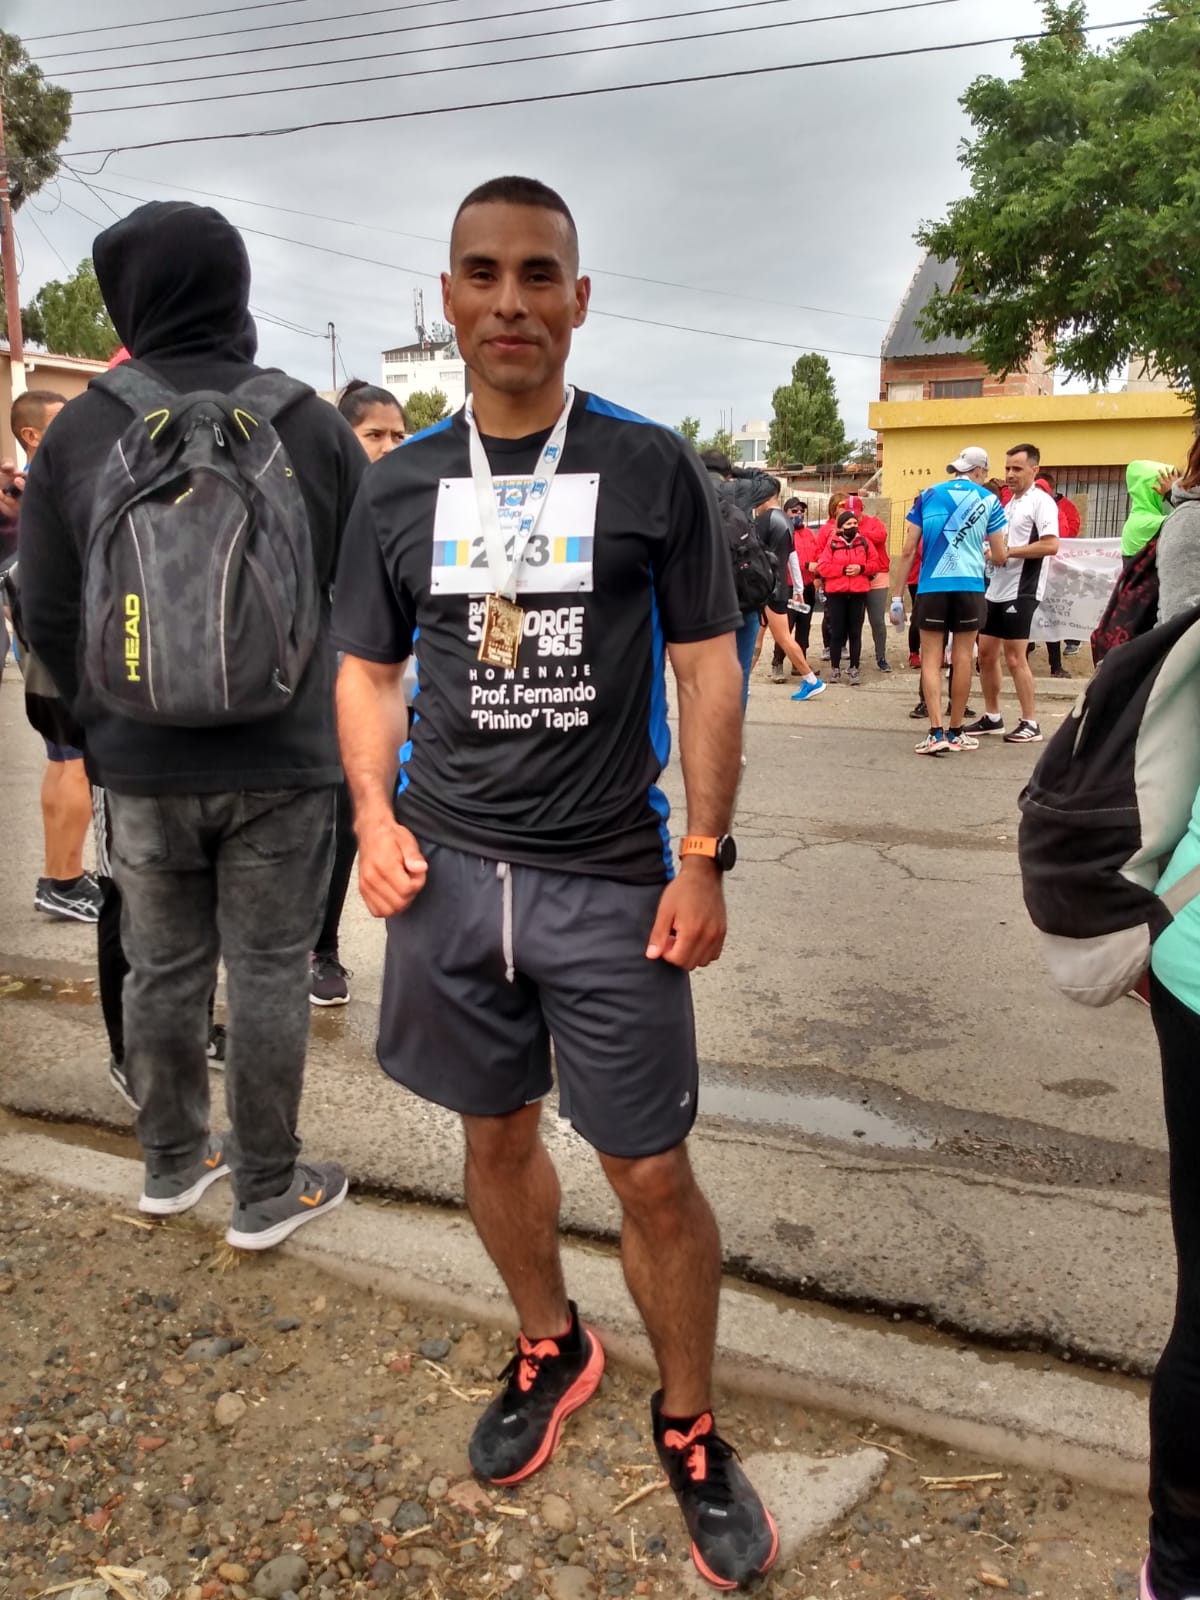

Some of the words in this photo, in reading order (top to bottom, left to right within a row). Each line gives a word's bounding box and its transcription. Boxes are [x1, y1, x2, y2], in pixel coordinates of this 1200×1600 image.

[125, 593, 141, 682] HEAD
[519, 606, 585, 645] ORGE
[537, 633, 583, 657] 96.5
[469, 664, 591, 681] HOMENAJE
[471, 684, 510, 705] Prof.
[513, 681, 597, 704] Fernando
[541, 707, 589, 732] Tapia
